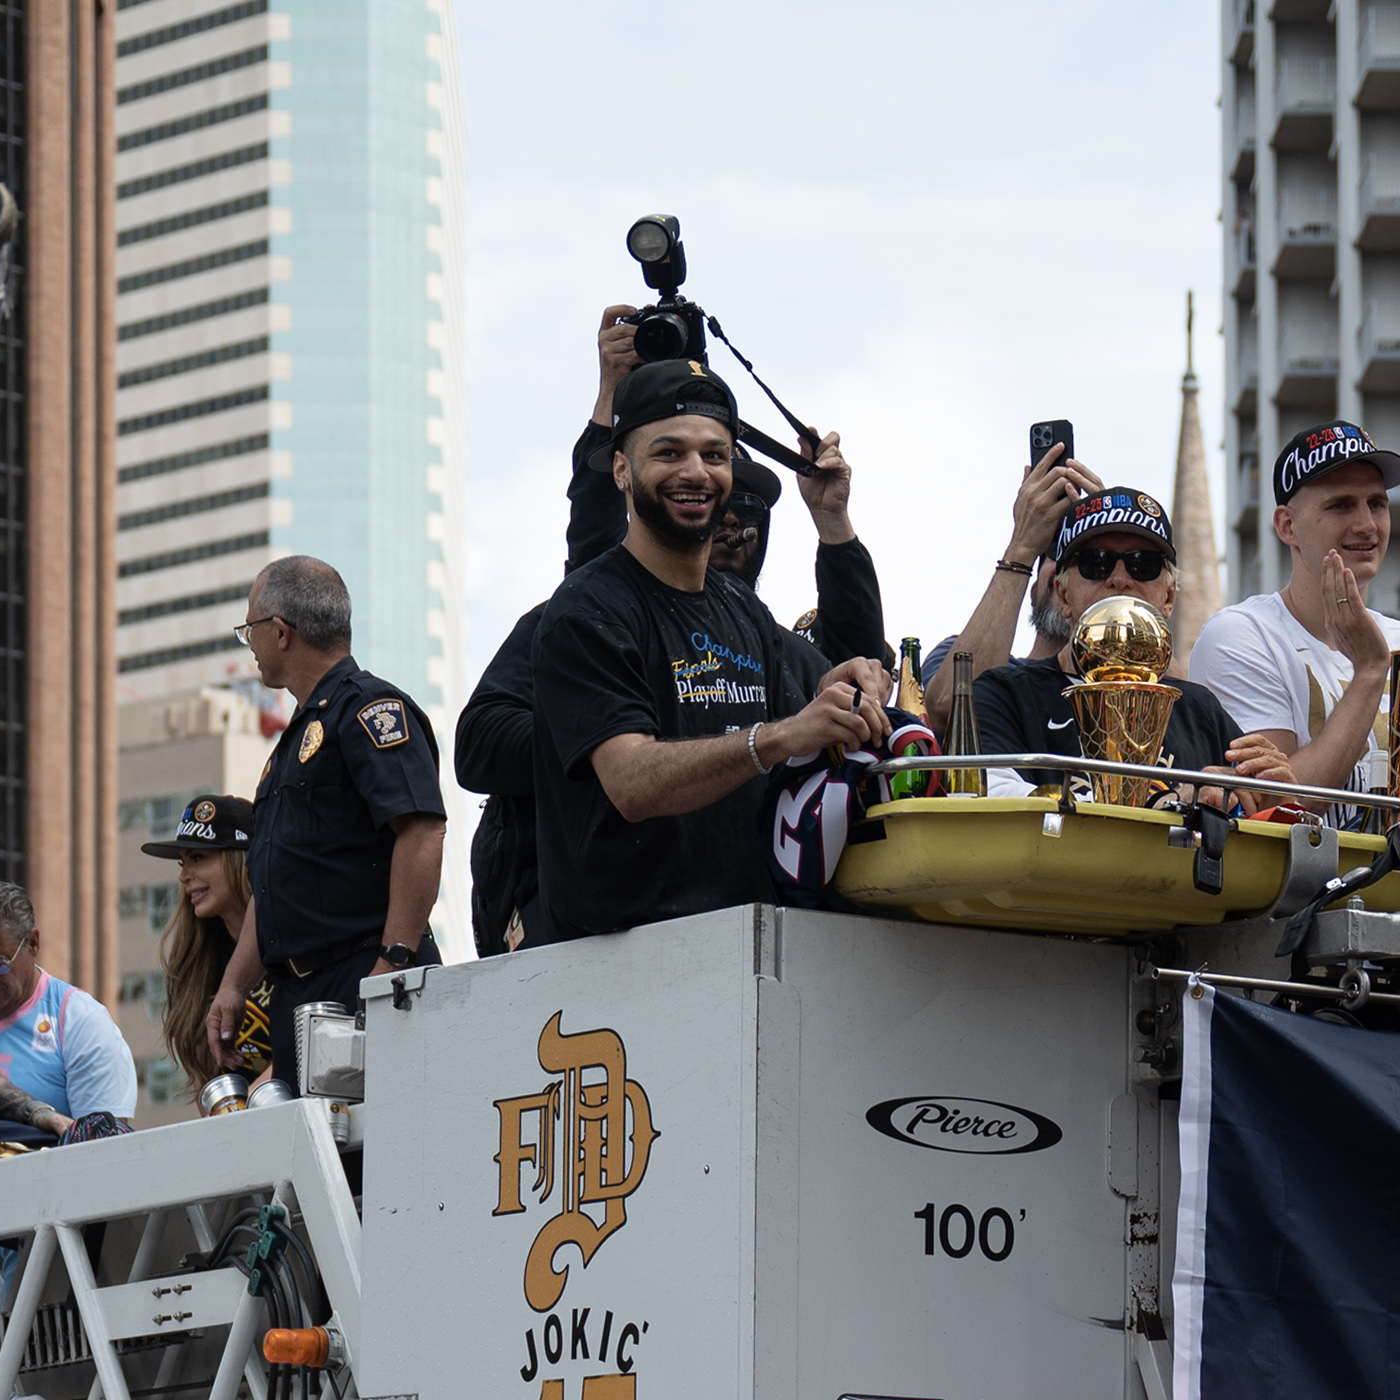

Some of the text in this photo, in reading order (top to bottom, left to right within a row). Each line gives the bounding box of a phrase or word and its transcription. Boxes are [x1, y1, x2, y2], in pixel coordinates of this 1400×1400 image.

[1306, 428, 1336, 449] 22-23
[1075, 494, 1132, 519] 22-23 NBA
[676, 678, 726, 710] Playoff
[360, 702, 401, 721] DENVER
[379, 730, 403, 744] FIRE
[906, 1103, 1018, 1139] Pierce
